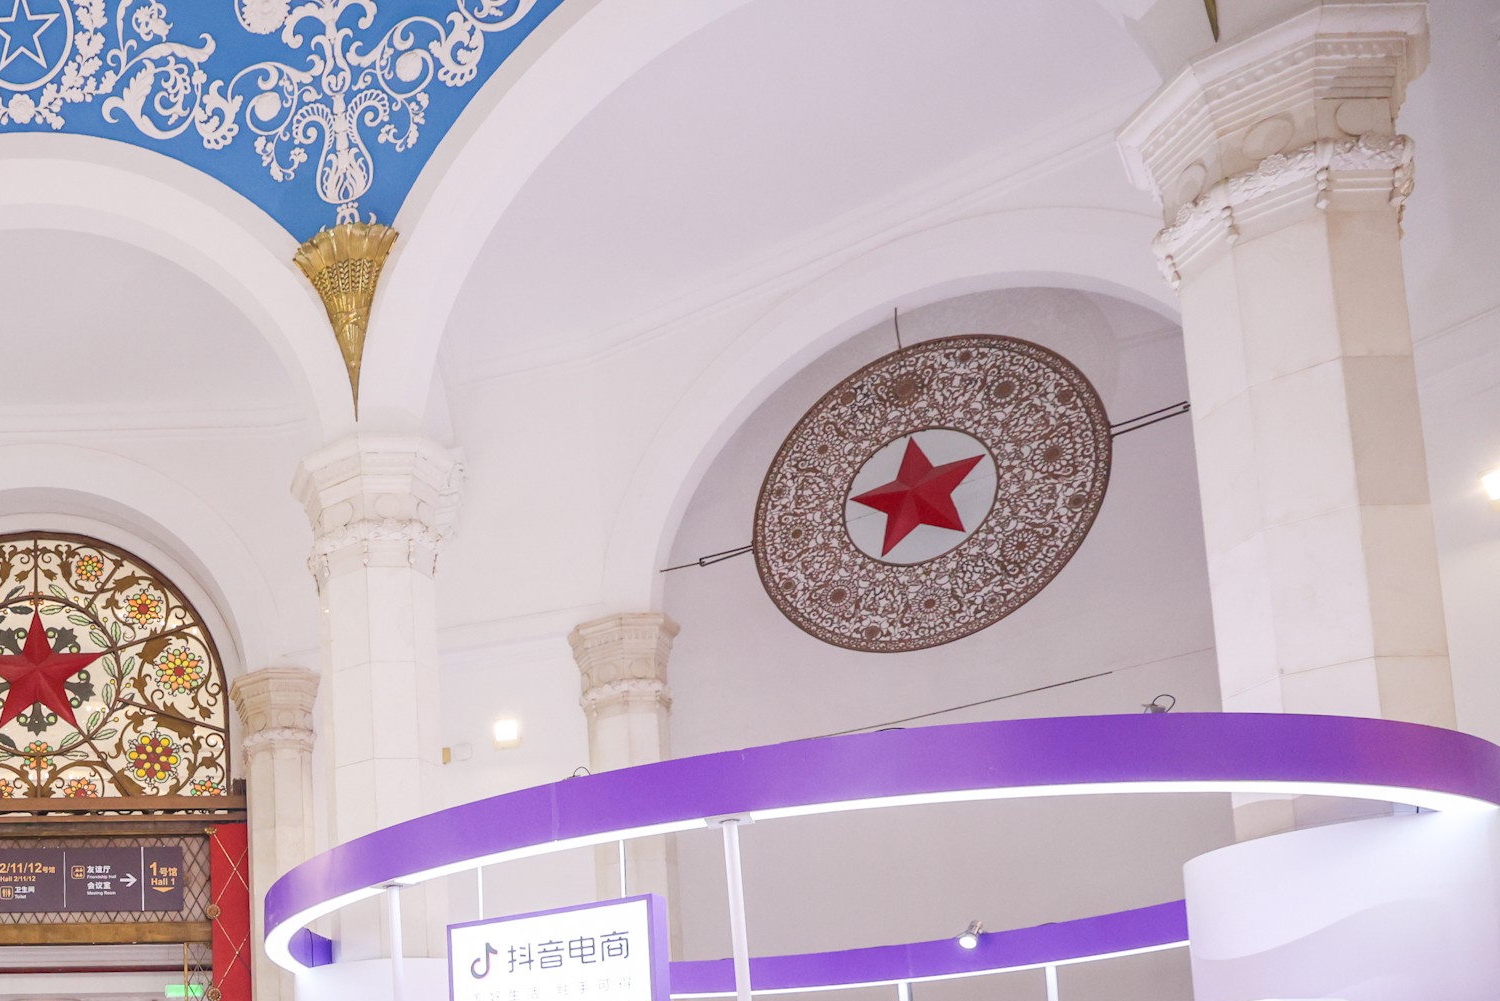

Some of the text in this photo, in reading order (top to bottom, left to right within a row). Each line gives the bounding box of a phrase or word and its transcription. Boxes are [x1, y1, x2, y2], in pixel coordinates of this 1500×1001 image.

[87, 866, 111, 874] 友谊厅
[149, 862, 178, 877] 1号馆
[87, 881, 111, 890] 会议室
[151, 878, 168, 886] Hall
[508, 931, 630, 973] 抖音电商
